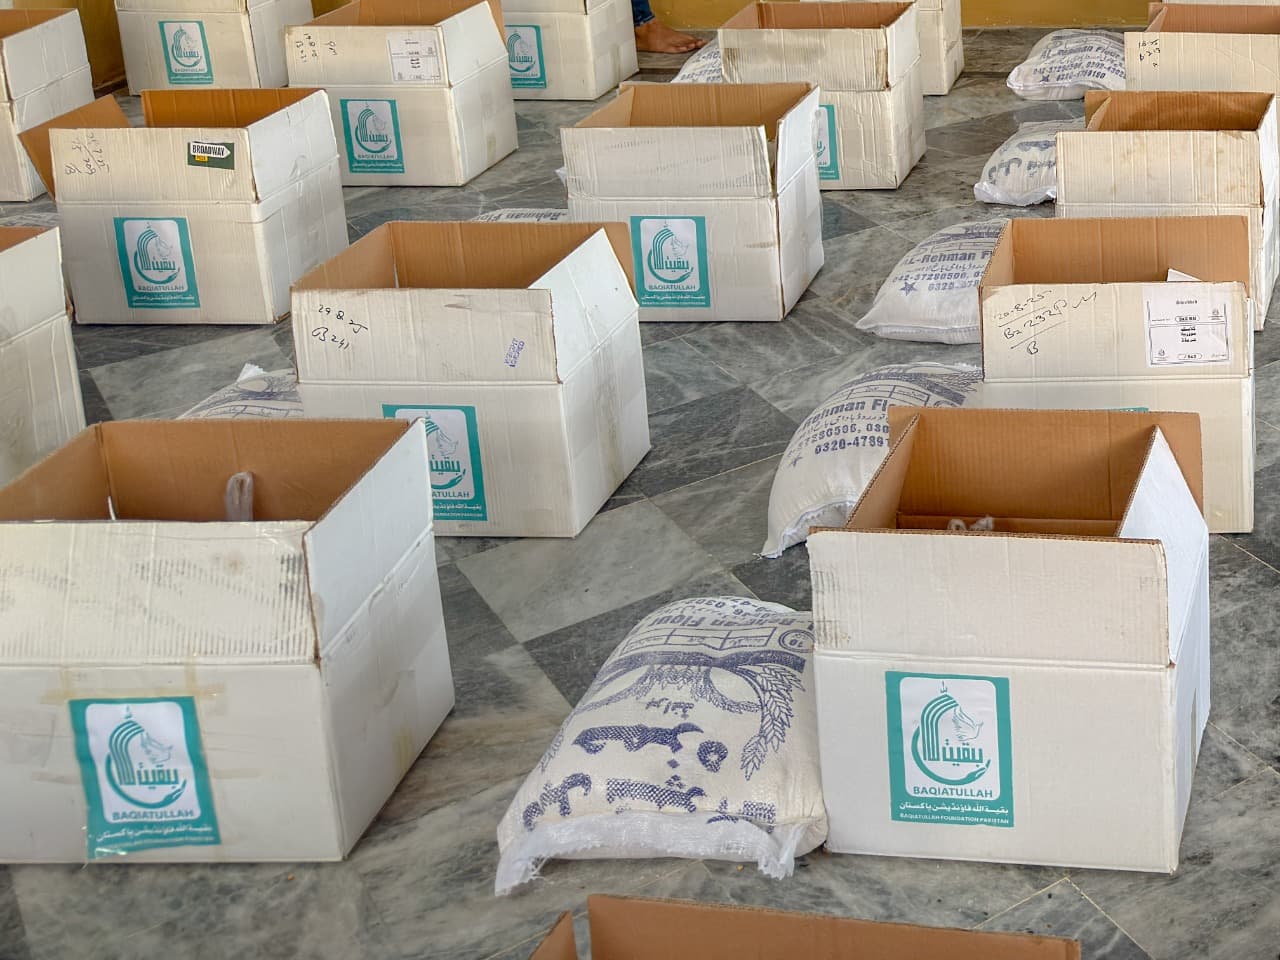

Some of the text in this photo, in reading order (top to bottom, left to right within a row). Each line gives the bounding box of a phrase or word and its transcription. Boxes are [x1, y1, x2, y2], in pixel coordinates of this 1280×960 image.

[192, 144, 225, 157] BROADWAY
[432, 490, 470, 498] ATULLAH
[572, 722, 729, 774] حمزہ
[913, 786, 993, 798] BAQIATULLAH
[112, 809, 194, 821] BAQIATULLAH
